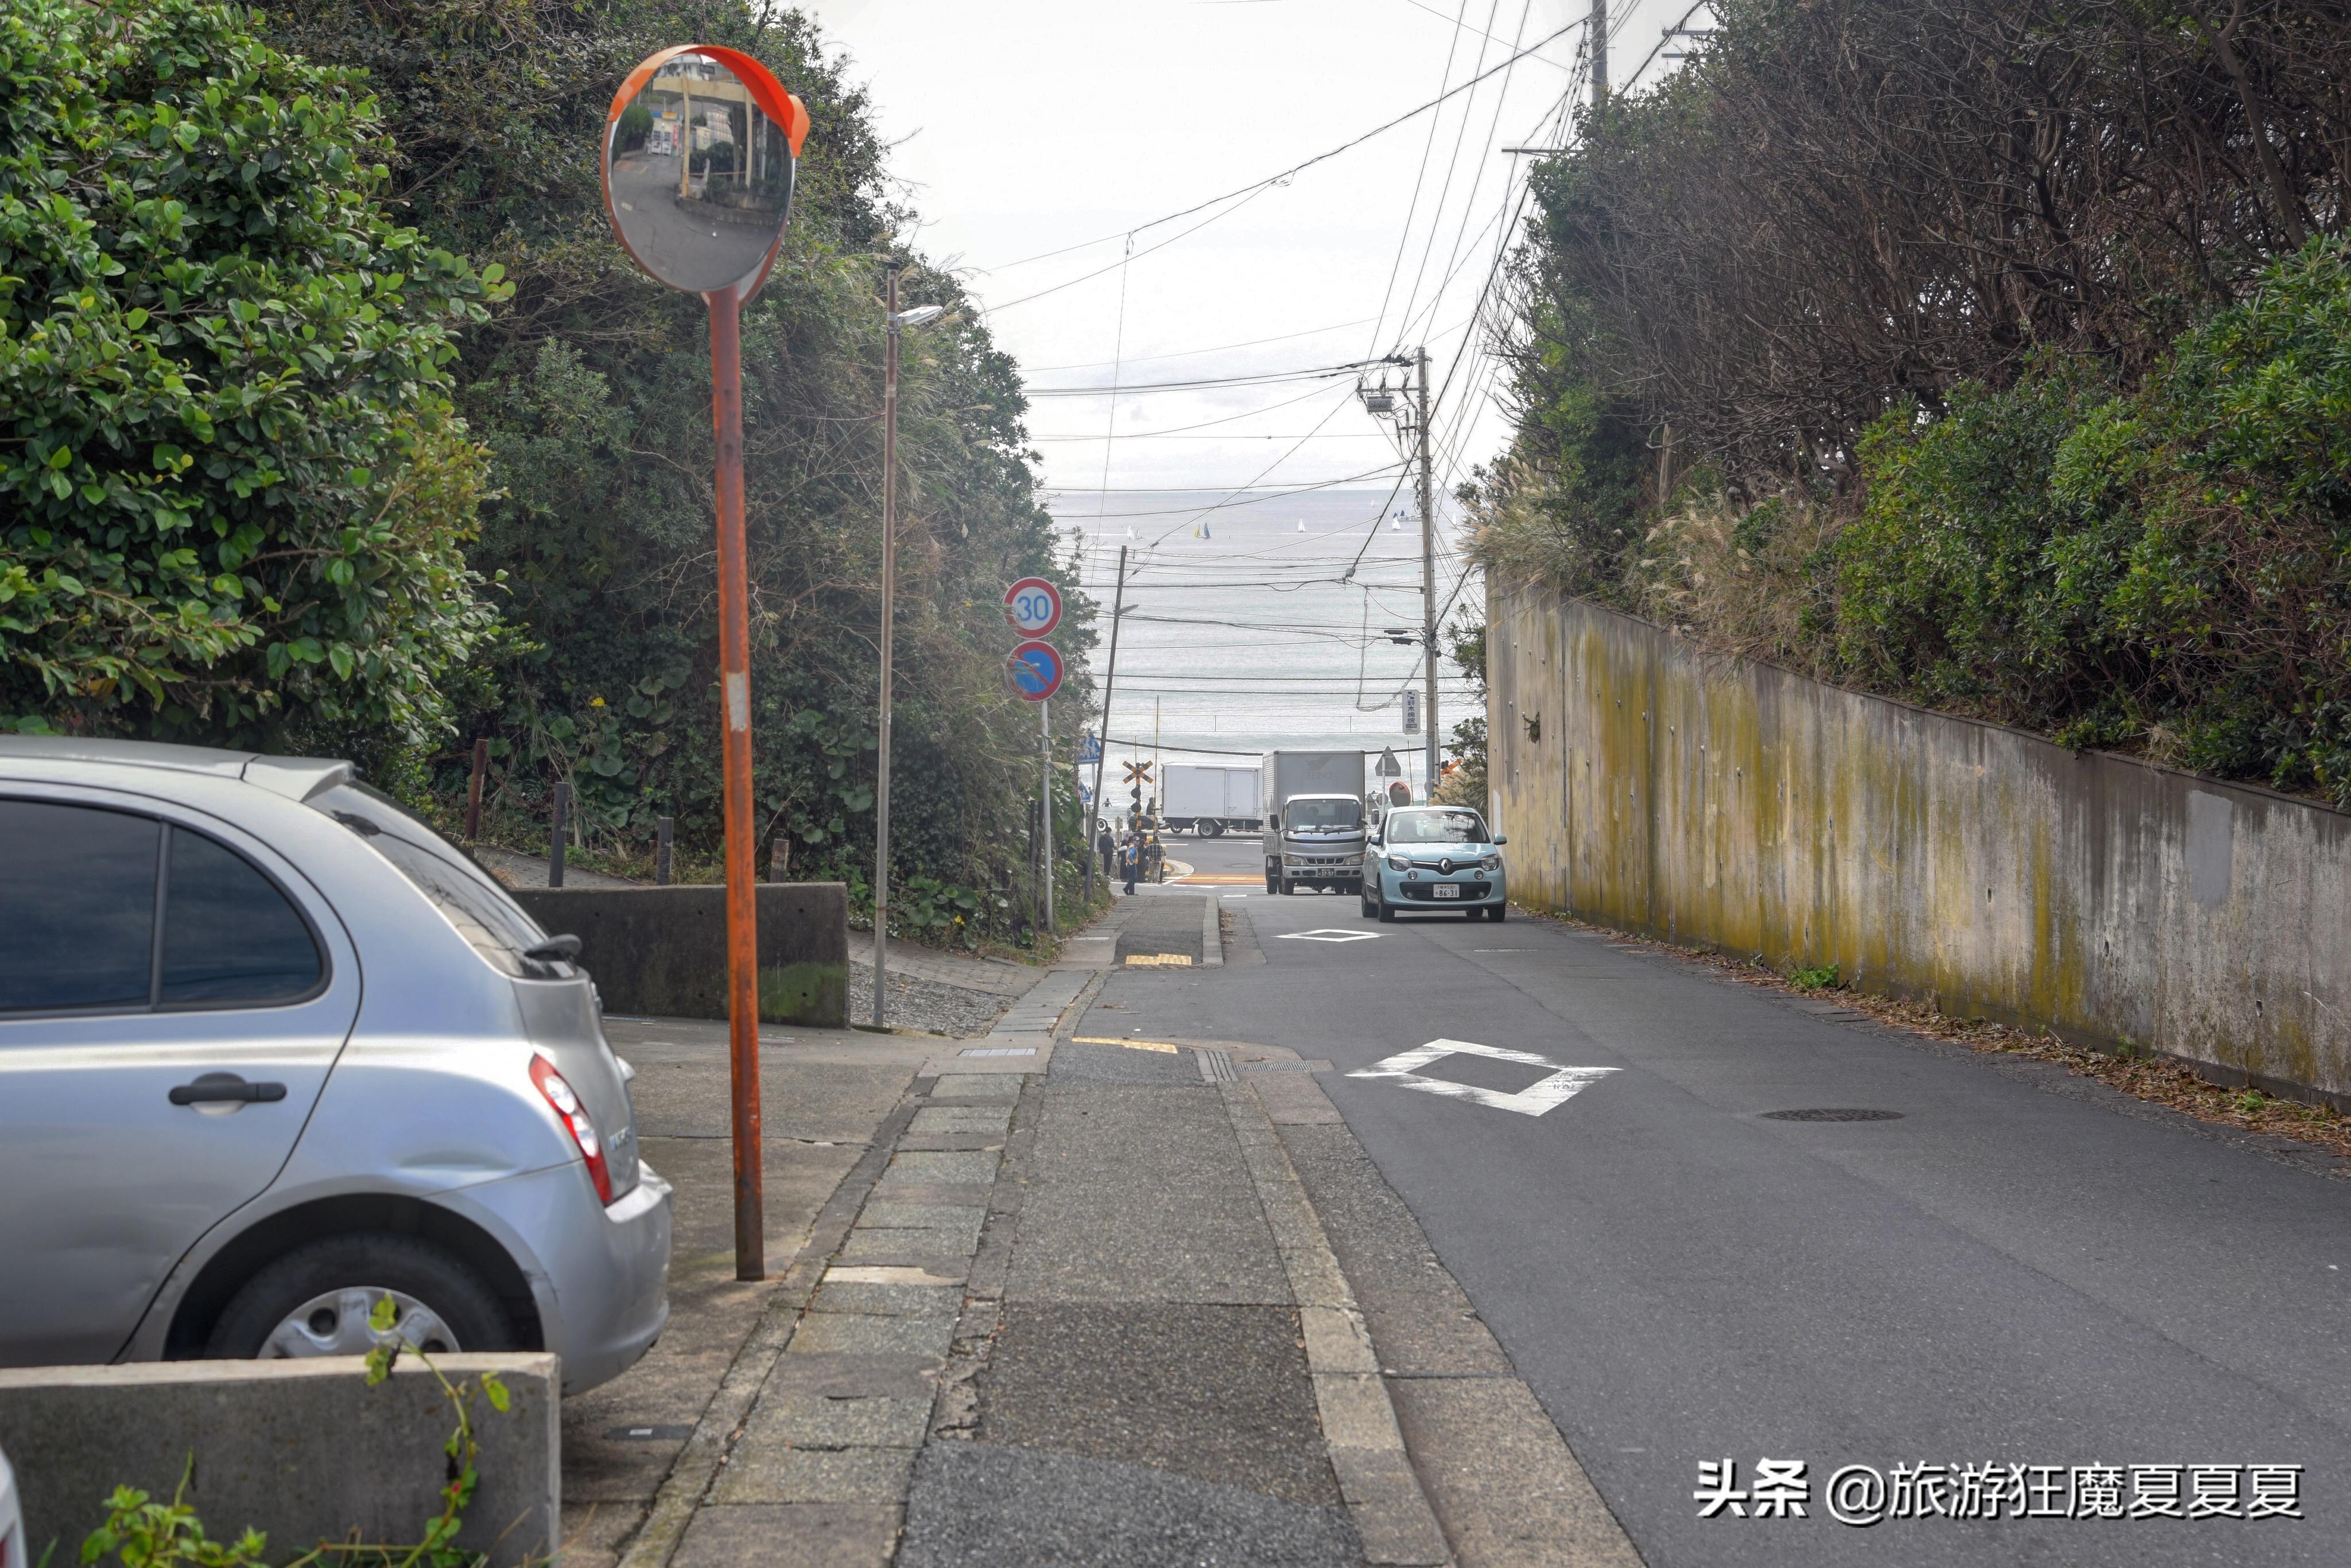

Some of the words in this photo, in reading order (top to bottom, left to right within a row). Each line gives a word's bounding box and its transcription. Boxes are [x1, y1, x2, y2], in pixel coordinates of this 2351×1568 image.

[1018, 595, 1049, 621] 30
[1407, 700, 1415, 723] 鈴木病院
